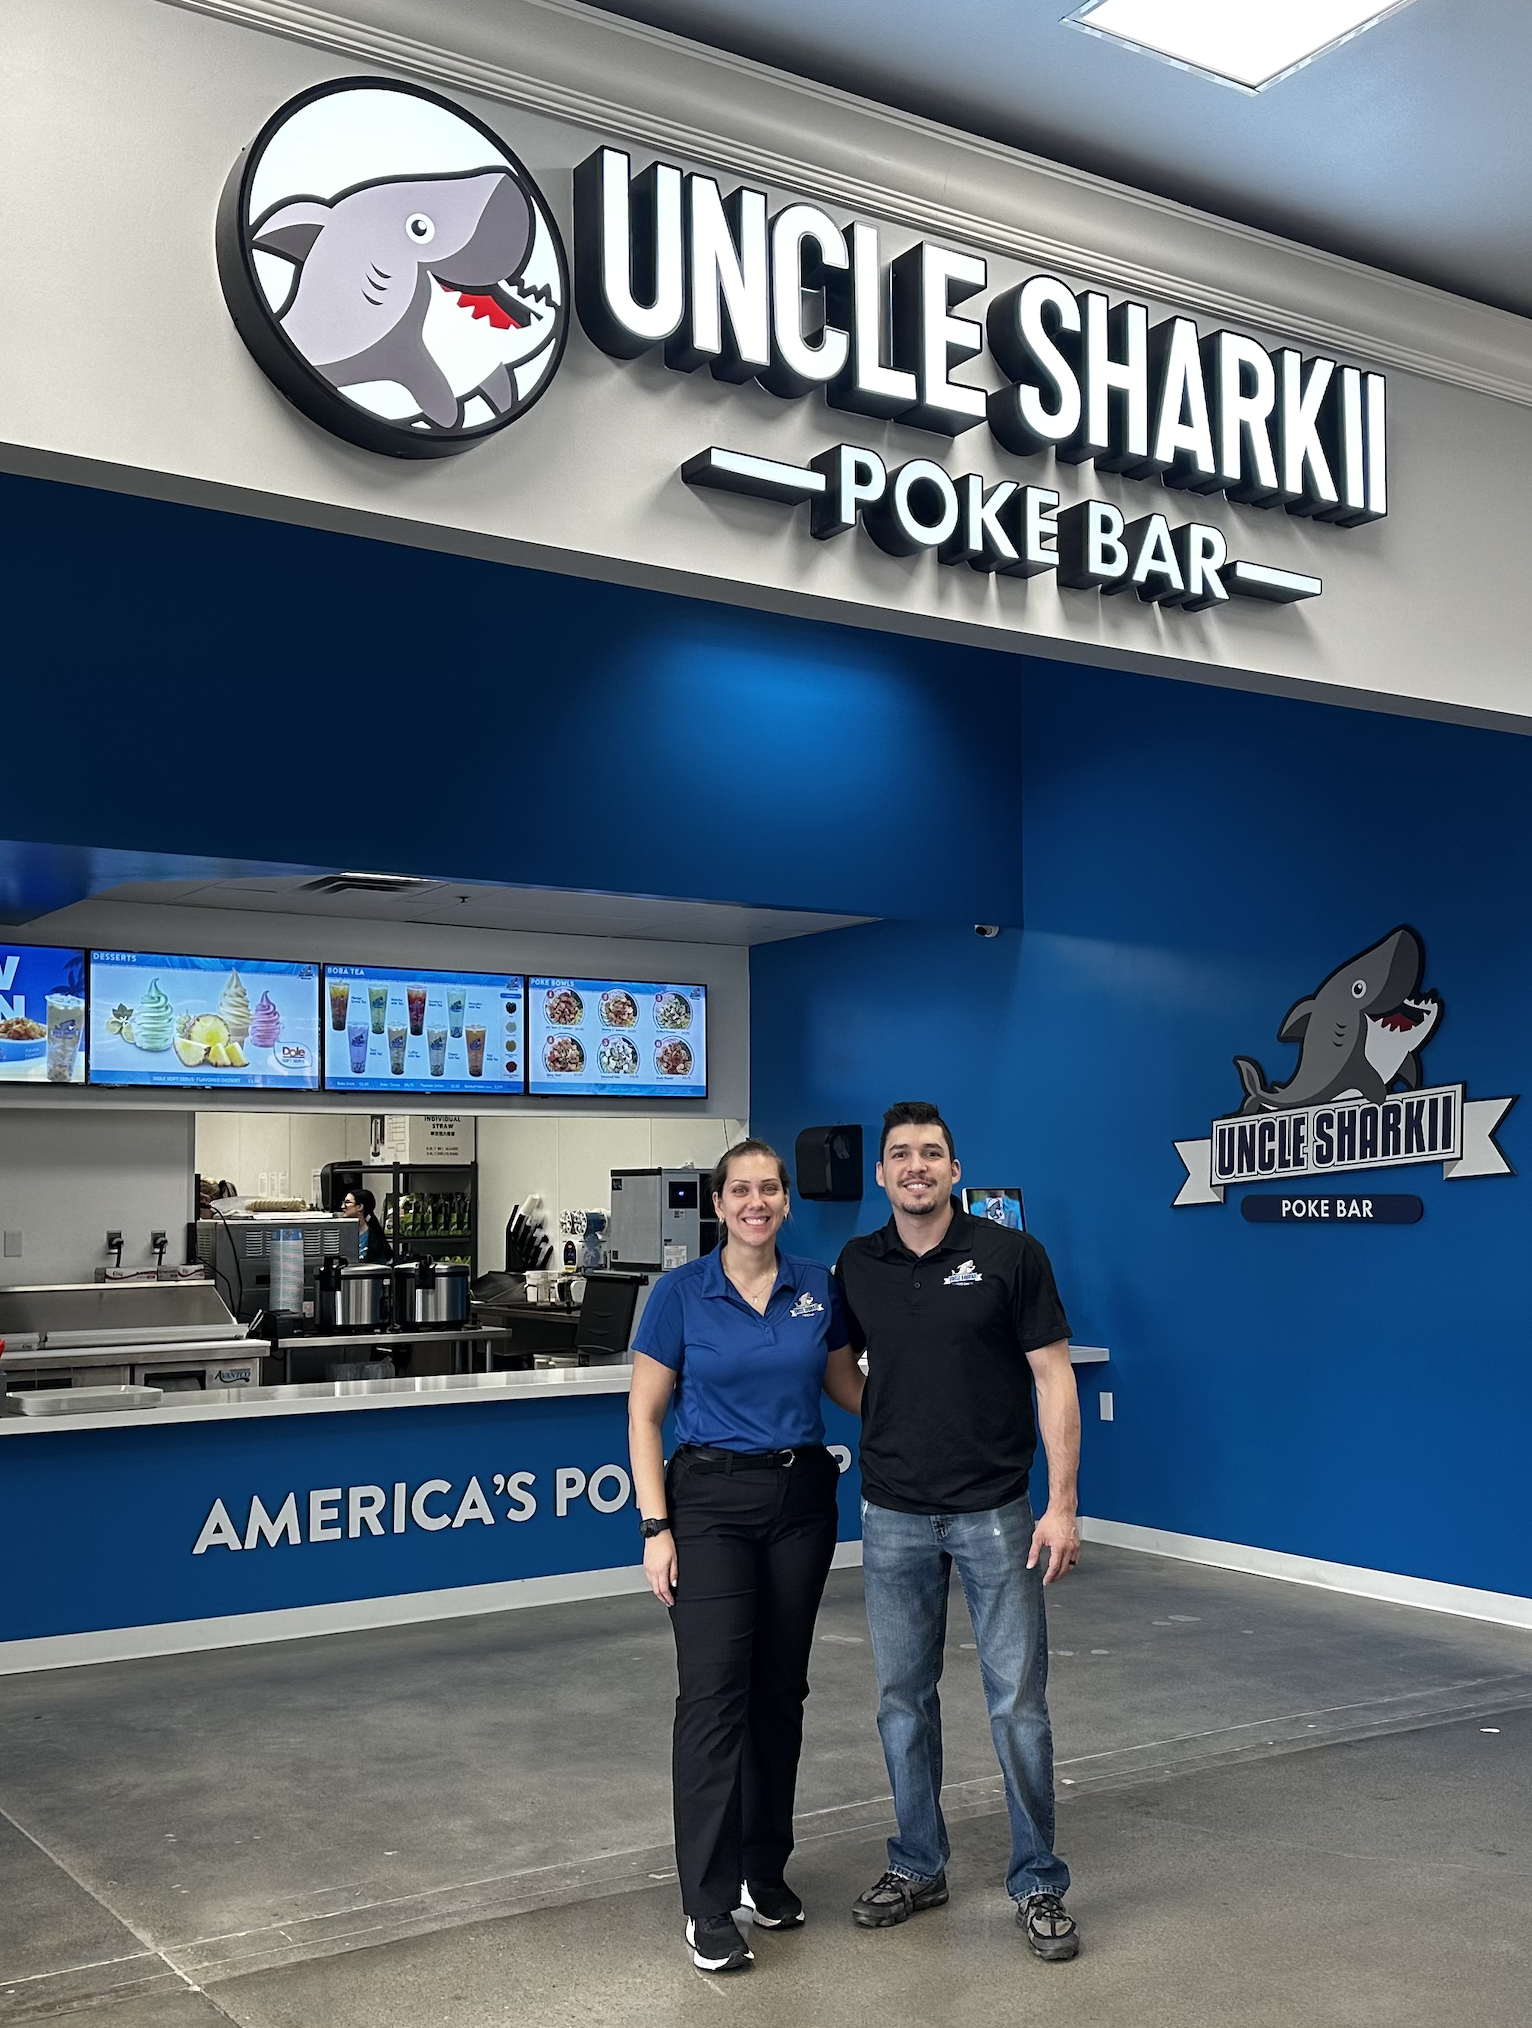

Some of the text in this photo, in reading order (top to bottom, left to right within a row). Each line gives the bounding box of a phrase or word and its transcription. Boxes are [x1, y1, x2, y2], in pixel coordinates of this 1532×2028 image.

[600, 147, 1387, 517] UNCLE SHARKII
[839, 444, 1229, 600] POKE BAR
[93, 952, 137, 962] DESSERTS
[327, 966, 365, 976] BOBA TEA
[530, 978, 549, 986] POKE
[282, 1046, 305, 1057] Dole
[1218, 1095, 1453, 1177] UNCLE SHARKII
[1281, 1199, 1374, 1218] POKE BAR
[192, 1471, 537, 1555] AMERICA’S
